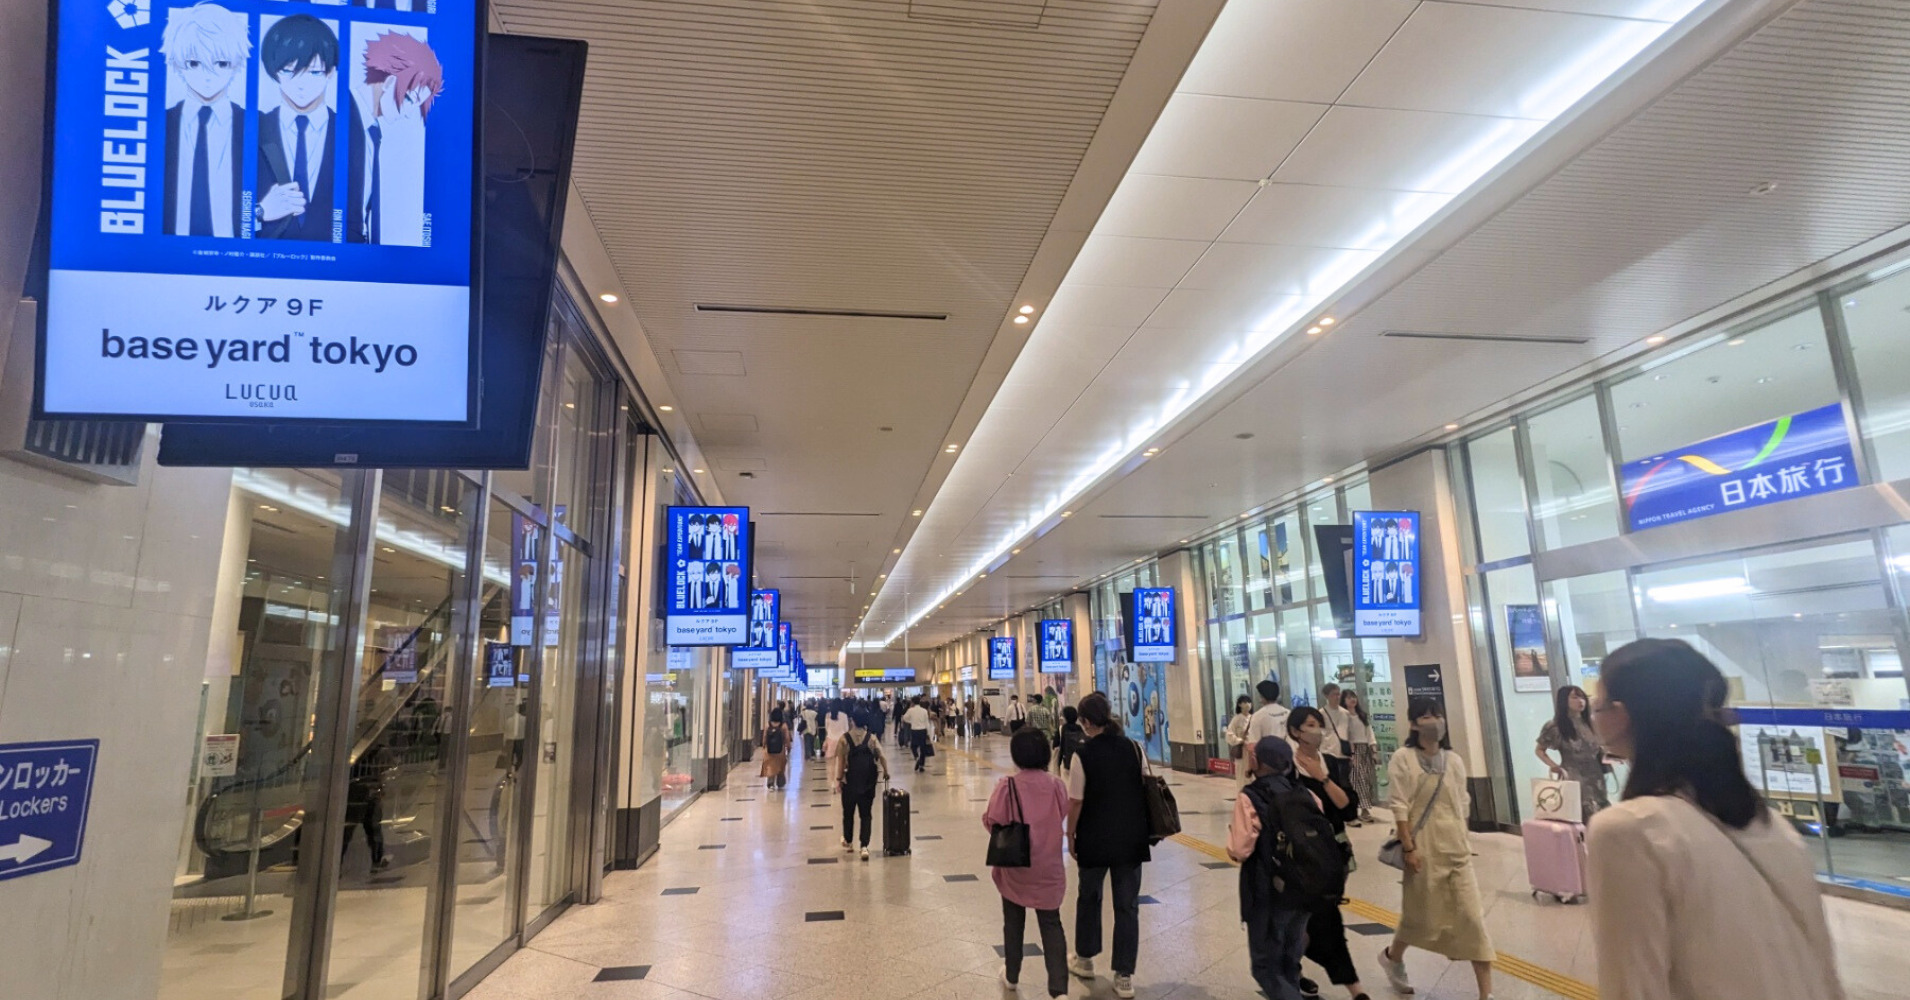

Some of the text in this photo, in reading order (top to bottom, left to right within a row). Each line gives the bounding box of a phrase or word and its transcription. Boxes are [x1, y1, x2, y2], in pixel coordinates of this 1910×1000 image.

[101, 45, 150, 235] BLUELOCK
[241, 190, 253, 239] SEISHIRO NAGI
[333, 208, 343, 221] RIN
[101, 329, 198, 361] base
[309, 336, 418, 372] tokyo
[1720, 456, 1846, 506] 日本旅行
[1638, 504, 1715, 525] NIPPON TRAVEL AGENCY
[676, 570, 686, 609] BLUELOCK
[676, 626, 694, 634] base
[715, 626, 737, 636] tokyo
[1824, 712, 1863, 722] 日本旅行
[0, 795, 69, 821] Lockers
